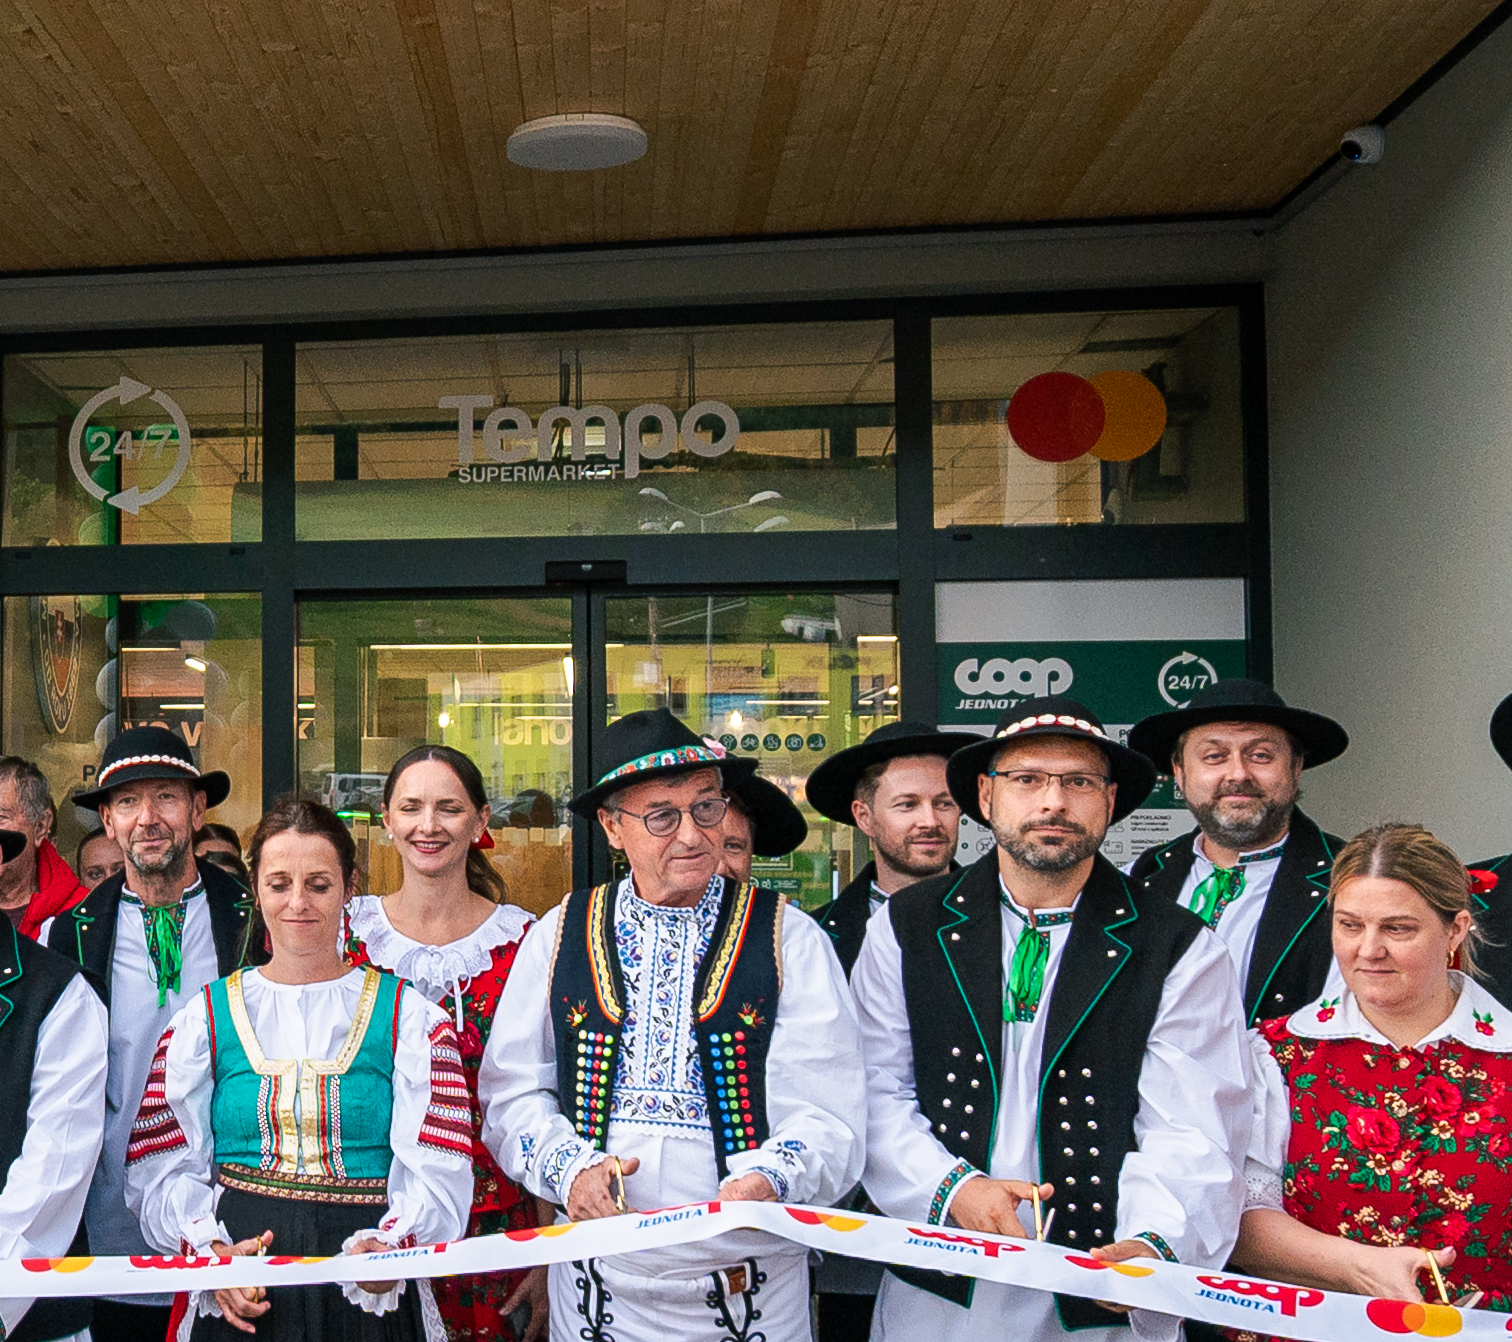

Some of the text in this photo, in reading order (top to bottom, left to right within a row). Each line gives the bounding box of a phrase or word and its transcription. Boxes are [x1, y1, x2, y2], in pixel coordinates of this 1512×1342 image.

[89, 430, 173, 462] 24/7
[438, 395, 740, 479] Tempo
[458, 463, 620, 483] SUPERMARKET
[954, 658, 1074, 699] coop
[1168, 675, 1208, 690] 24/7
[955, 698, 1027, 709] JEDNOT
[903, 1237, 978, 1255] JEDNOTA
[1195, 1289, 1274, 1313] JEDNOTA
[1196, 1275, 1325, 1317] coop
